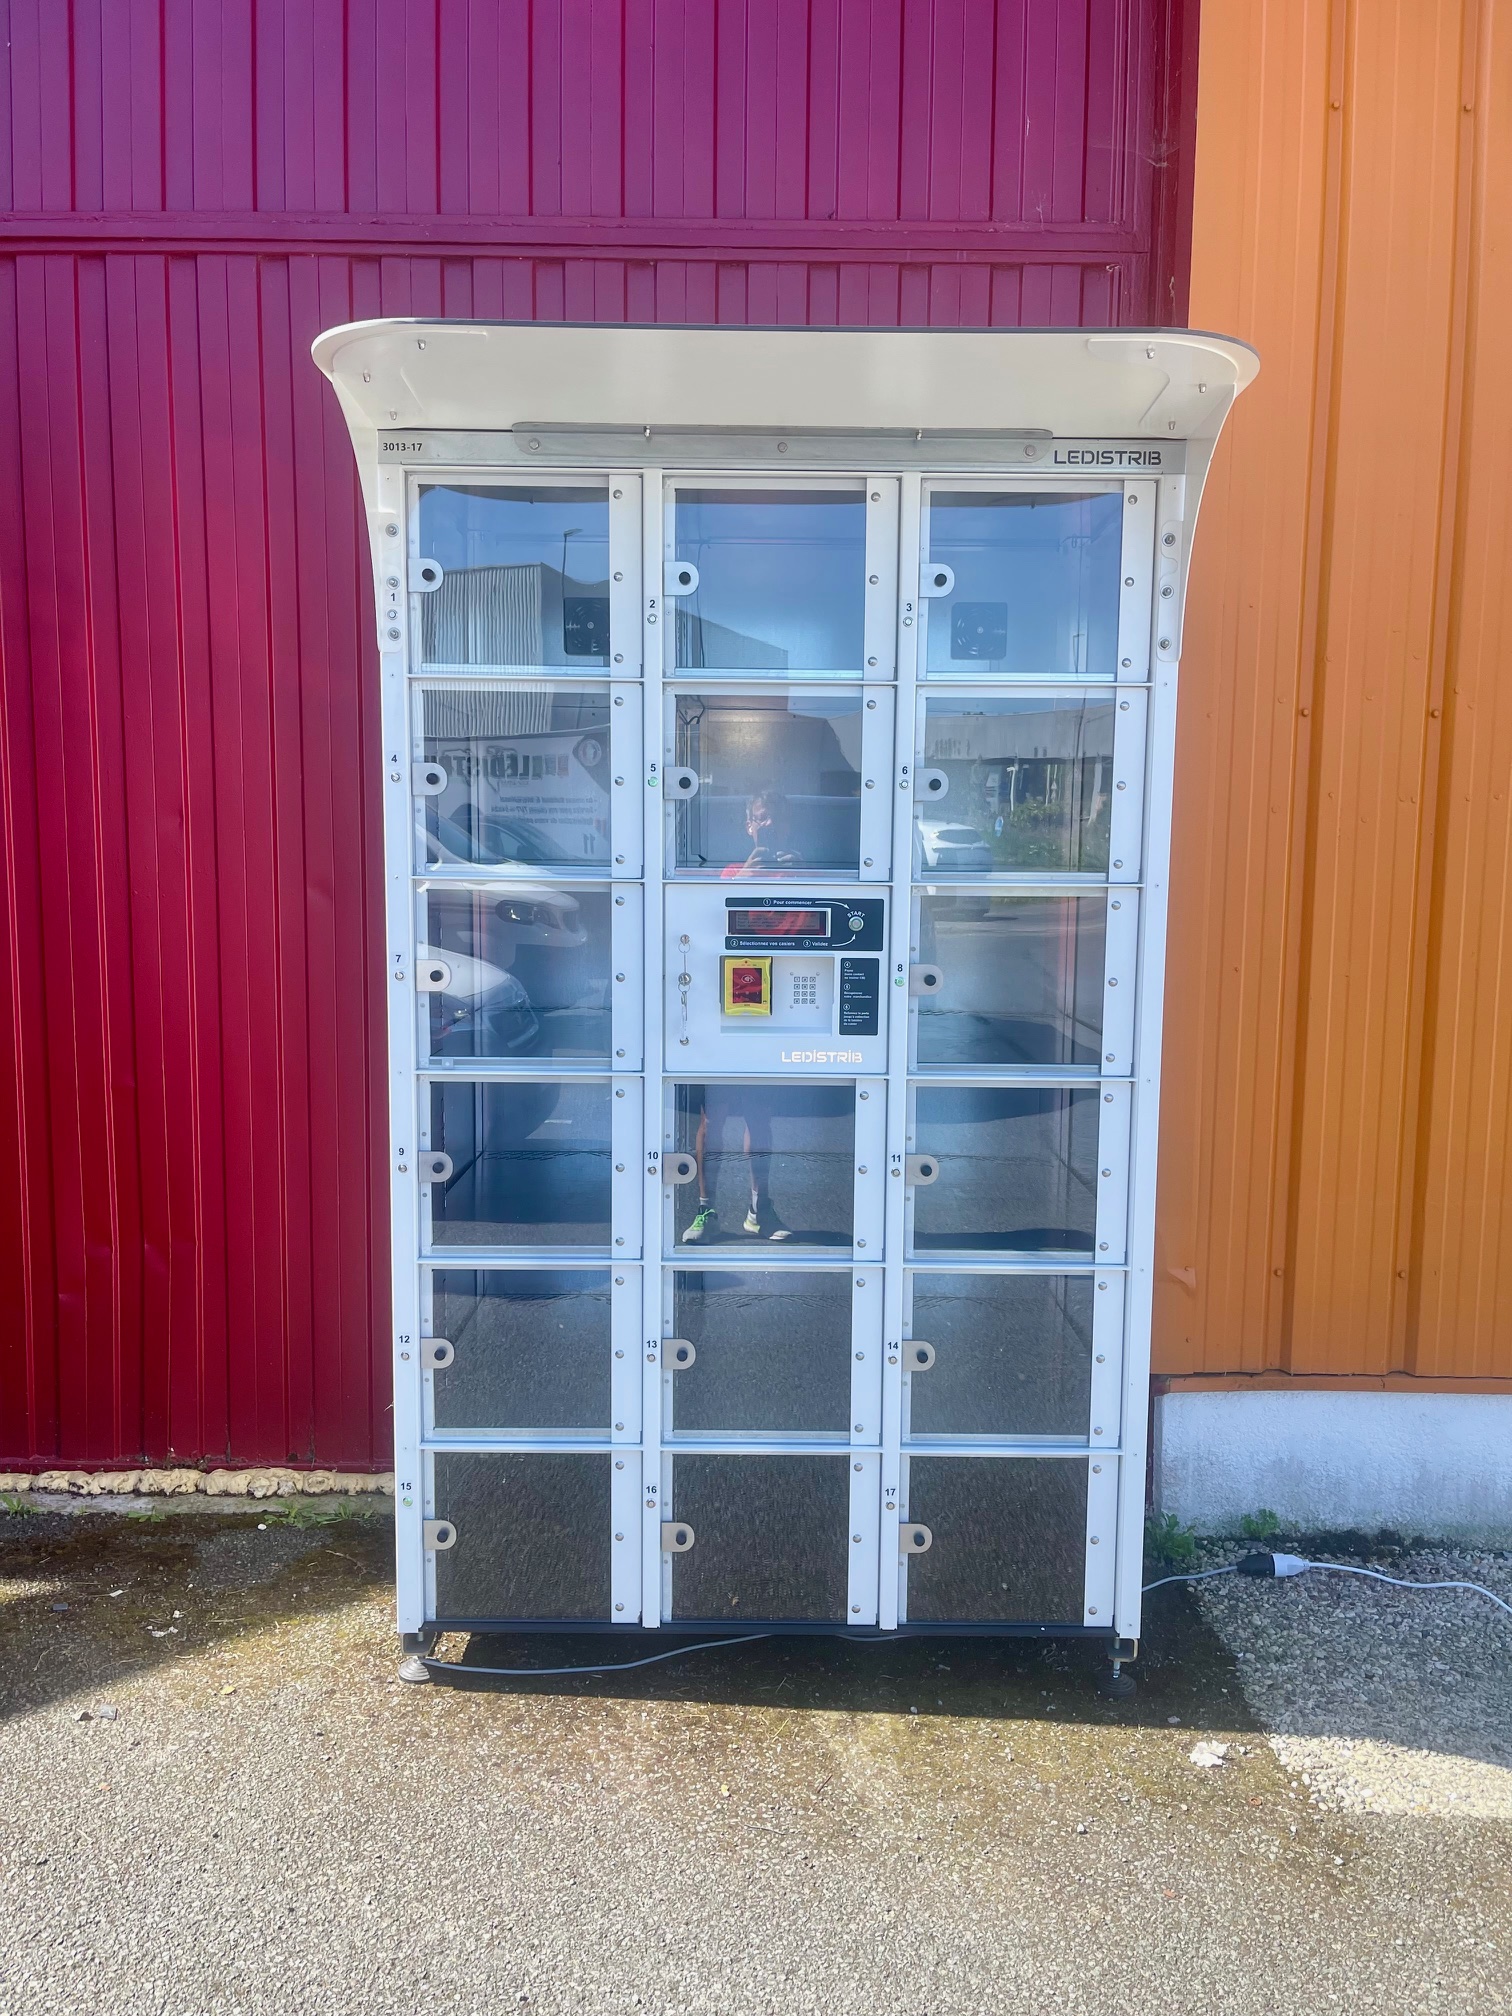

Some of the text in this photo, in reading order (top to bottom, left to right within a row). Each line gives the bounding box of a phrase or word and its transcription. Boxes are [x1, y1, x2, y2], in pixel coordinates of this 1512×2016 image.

[382, 442, 422, 451] 3013-17
[1054, 450, 1161, 465] LEDISTRIB
[390, 593, 396, 601] 1
[650, 600, 656, 608] 2
[906, 603, 912, 611] 3
[650, 764, 656, 772] 5
[902, 766, 908, 774] 6
[896, 964, 904, 972] 8
[648, 1151, 658, 1159] 10
[892, 1154, 900, 1162] 11
[398, 1335, 410, 1343] 12
[646, 1340, 658, 1348] 13
[884, 1488, 896, 1496] 17
